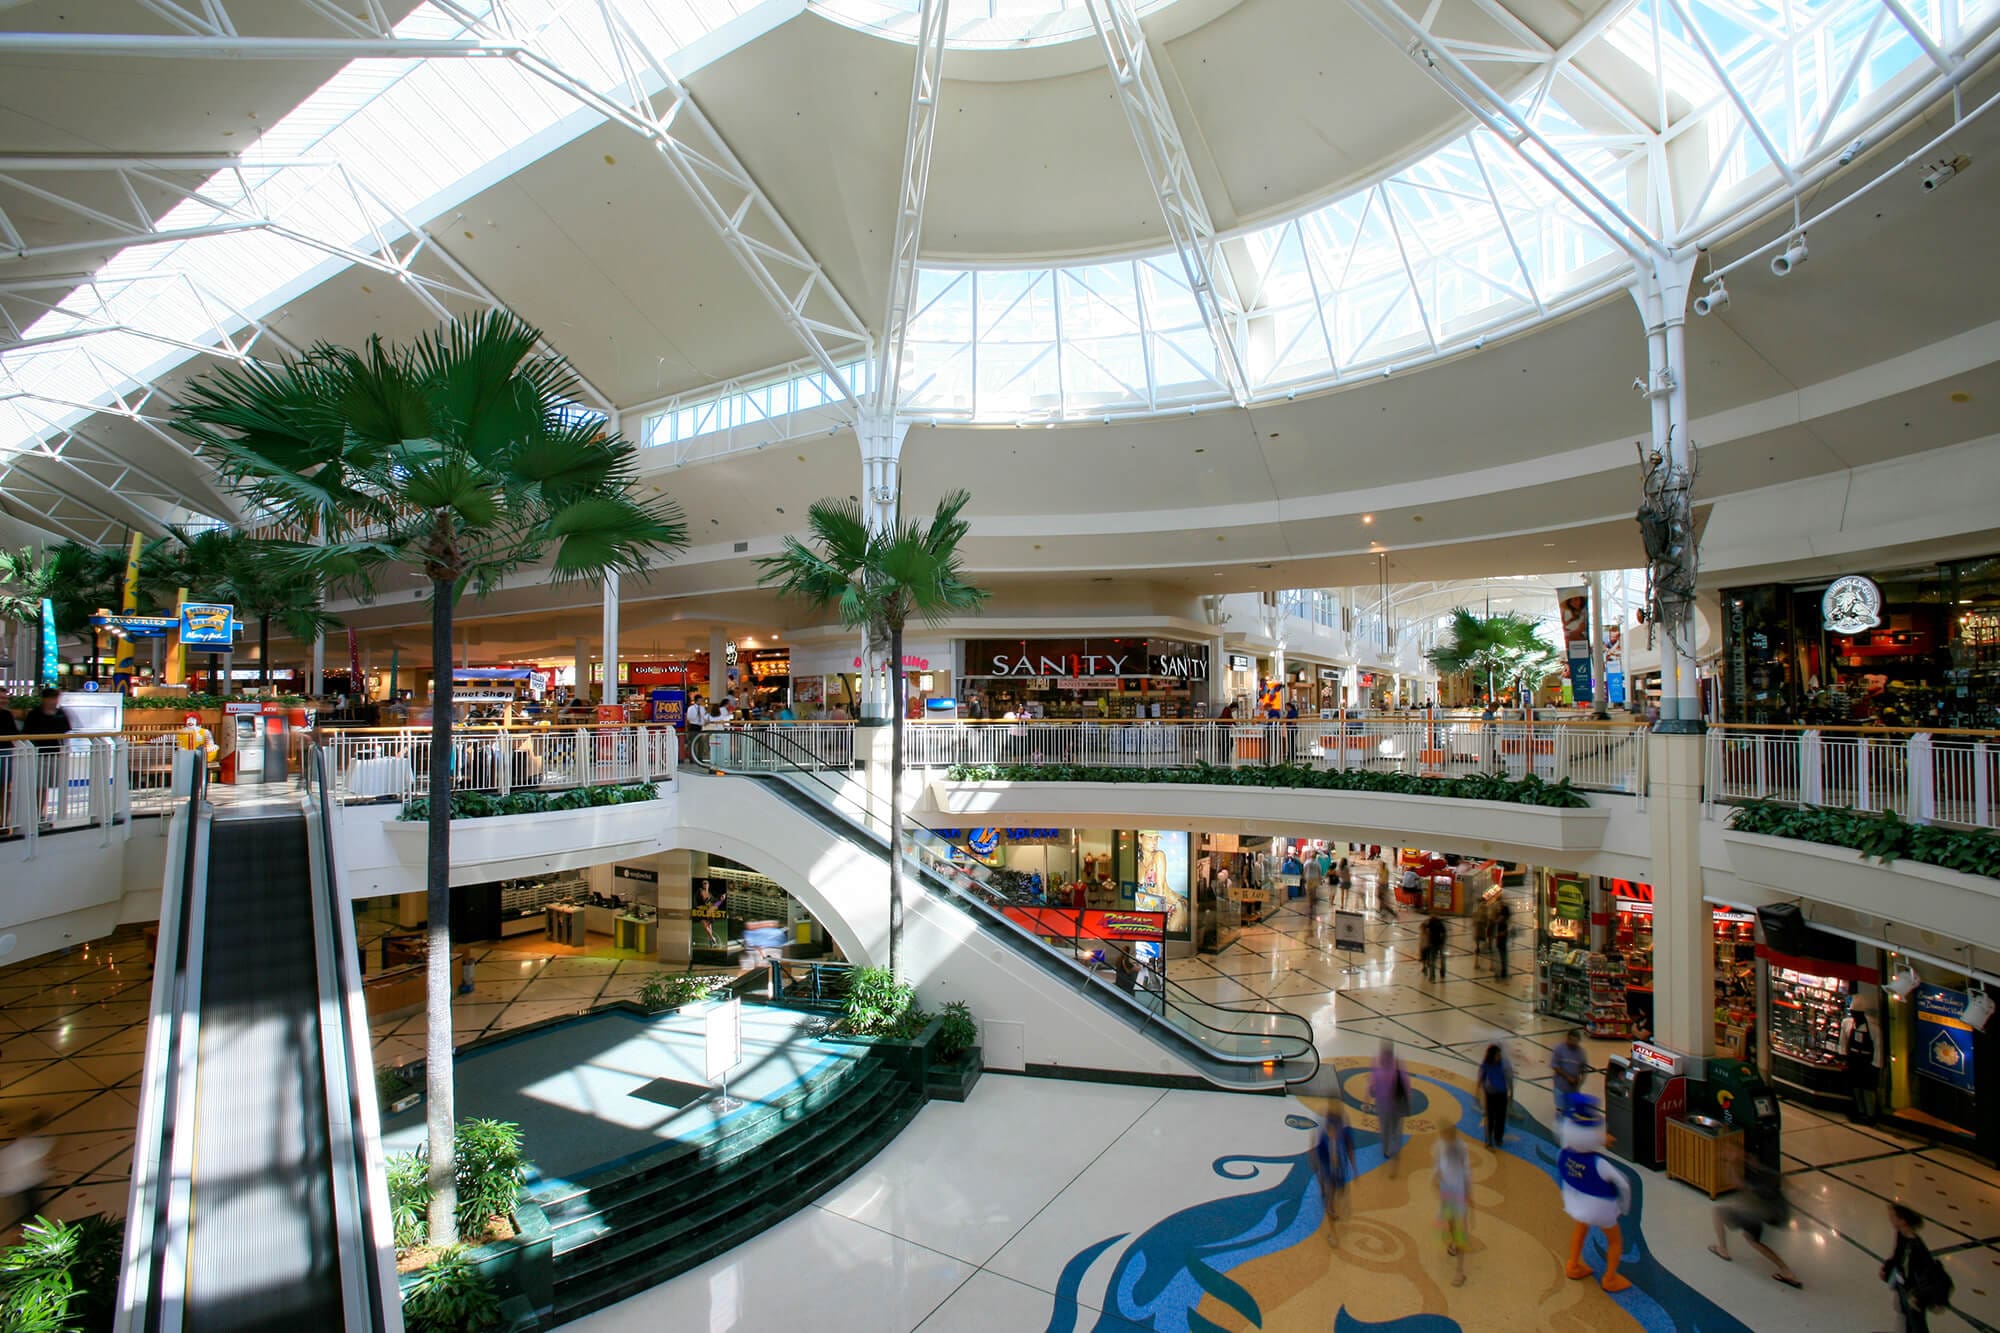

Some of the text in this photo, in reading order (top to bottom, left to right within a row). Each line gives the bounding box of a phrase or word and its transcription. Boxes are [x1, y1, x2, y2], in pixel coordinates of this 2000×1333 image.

[105, 617, 166, 626] SAVOURIES
[991, 654, 1128, 679] SANITY
[1160, 655, 1207, 680] SANITY
[482, 689, 512, 699] Shop
[659, 702, 678, 713] FOX
[1636, 1047, 1653, 1057] ATM
